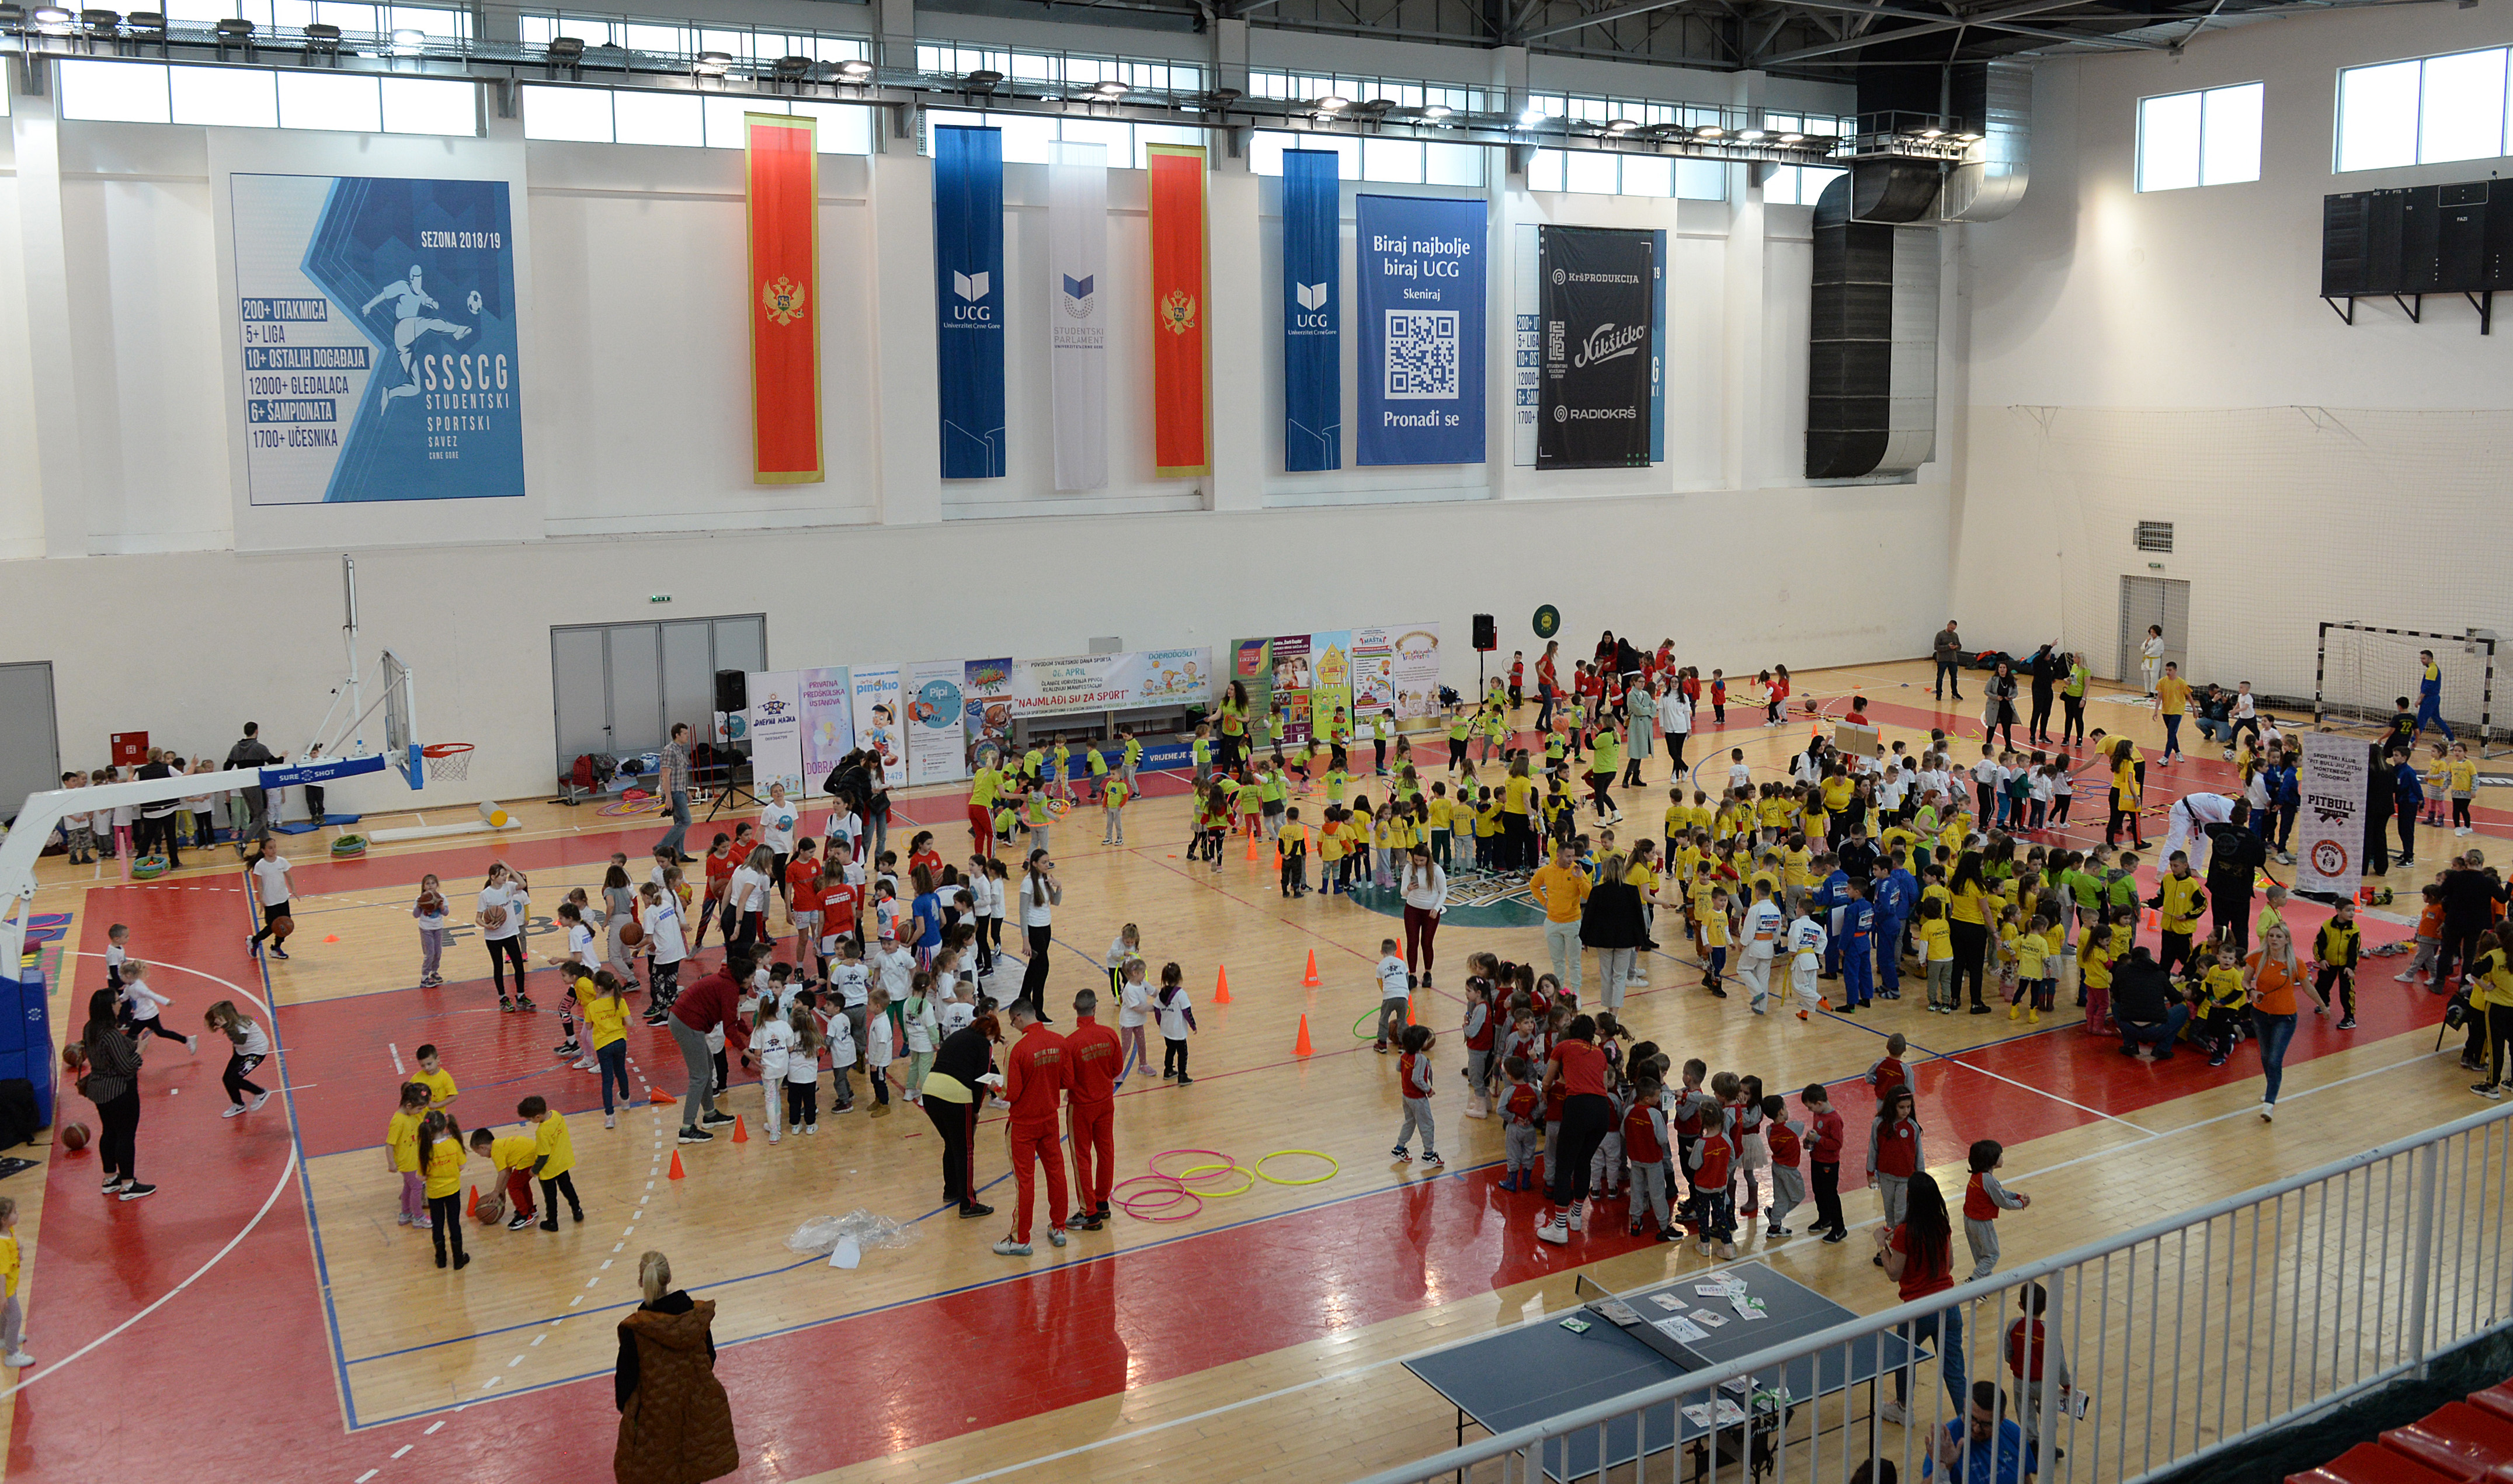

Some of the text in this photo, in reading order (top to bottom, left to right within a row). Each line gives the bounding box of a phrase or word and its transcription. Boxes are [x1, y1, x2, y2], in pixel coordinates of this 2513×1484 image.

[421, 231, 500, 248] SEZONA 2018/19
[1374, 236, 1470, 258] Biraj najbolje
[1384, 259, 1459, 279] biraj UCG
[1569, 273, 1639, 284] KršPRODUKCIJA
[1403, 289, 1440, 301] Skeniraj
[244, 300, 326, 319] 200+ UTAKMICA
[954, 306, 989, 320] UCG
[1297, 315, 1327, 327] UCG
[1518, 317, 1532, 330] 200+
[246, 325, 285, 343] 5+ LIGA
[1518, 335, 1525, 347] 5+
[1575, 324, 1644, 367] Nikšićko
[248, 349, 365, 367] 10+ OSTALIH DOGAĐAJA
[1518, 352, 1528, 366] 10+
[424, 354, 508, 391] SSSCG
[1518, 372, 1539, 385] 12000+
[249, 377, 349, 394] 12000+ GLEDALACA
[426, 394, 509, 409] STUDENTSKI
[1518, 391, 1525, 404] 6+
[251, 400, 332, 421] 6+ ŠAMPIONATA
[1571, 406, 1636, 419] RADIOKRŠ
[427, 416, 490, 432] SPORTSKI
[1384, 410, 1459, 426] Pronađi se
[1518, 411, 1535, 424] 1700+
[253, 426, 338, 447] 1700+ UČESNIKA
[428, 436, 457, 447] SAVEZ
[1149, 651, 1192, 660] DOBRODOŠLI
[1066, 668, 1086, 676] APRIL
[804, 688, 845, 698] PREDŠKOLSKA
[930, 686, 947, 699] Pipi
[1069, 694, 1080, 703] SU
[1083, 693, 1094, 702] ZA
[810, 698, 840, 707] USTANOVA
[754, 718, 775, 727] DNEVNA
[2400, 722, 2413, 732] 22
[315, 769, 335, 777] SHOT
[807, 761, 833, 774] DOBRA
[2317, 773, 2349, 782] PODGORICA
[2308, 794, 2355, 812] PITBULL
